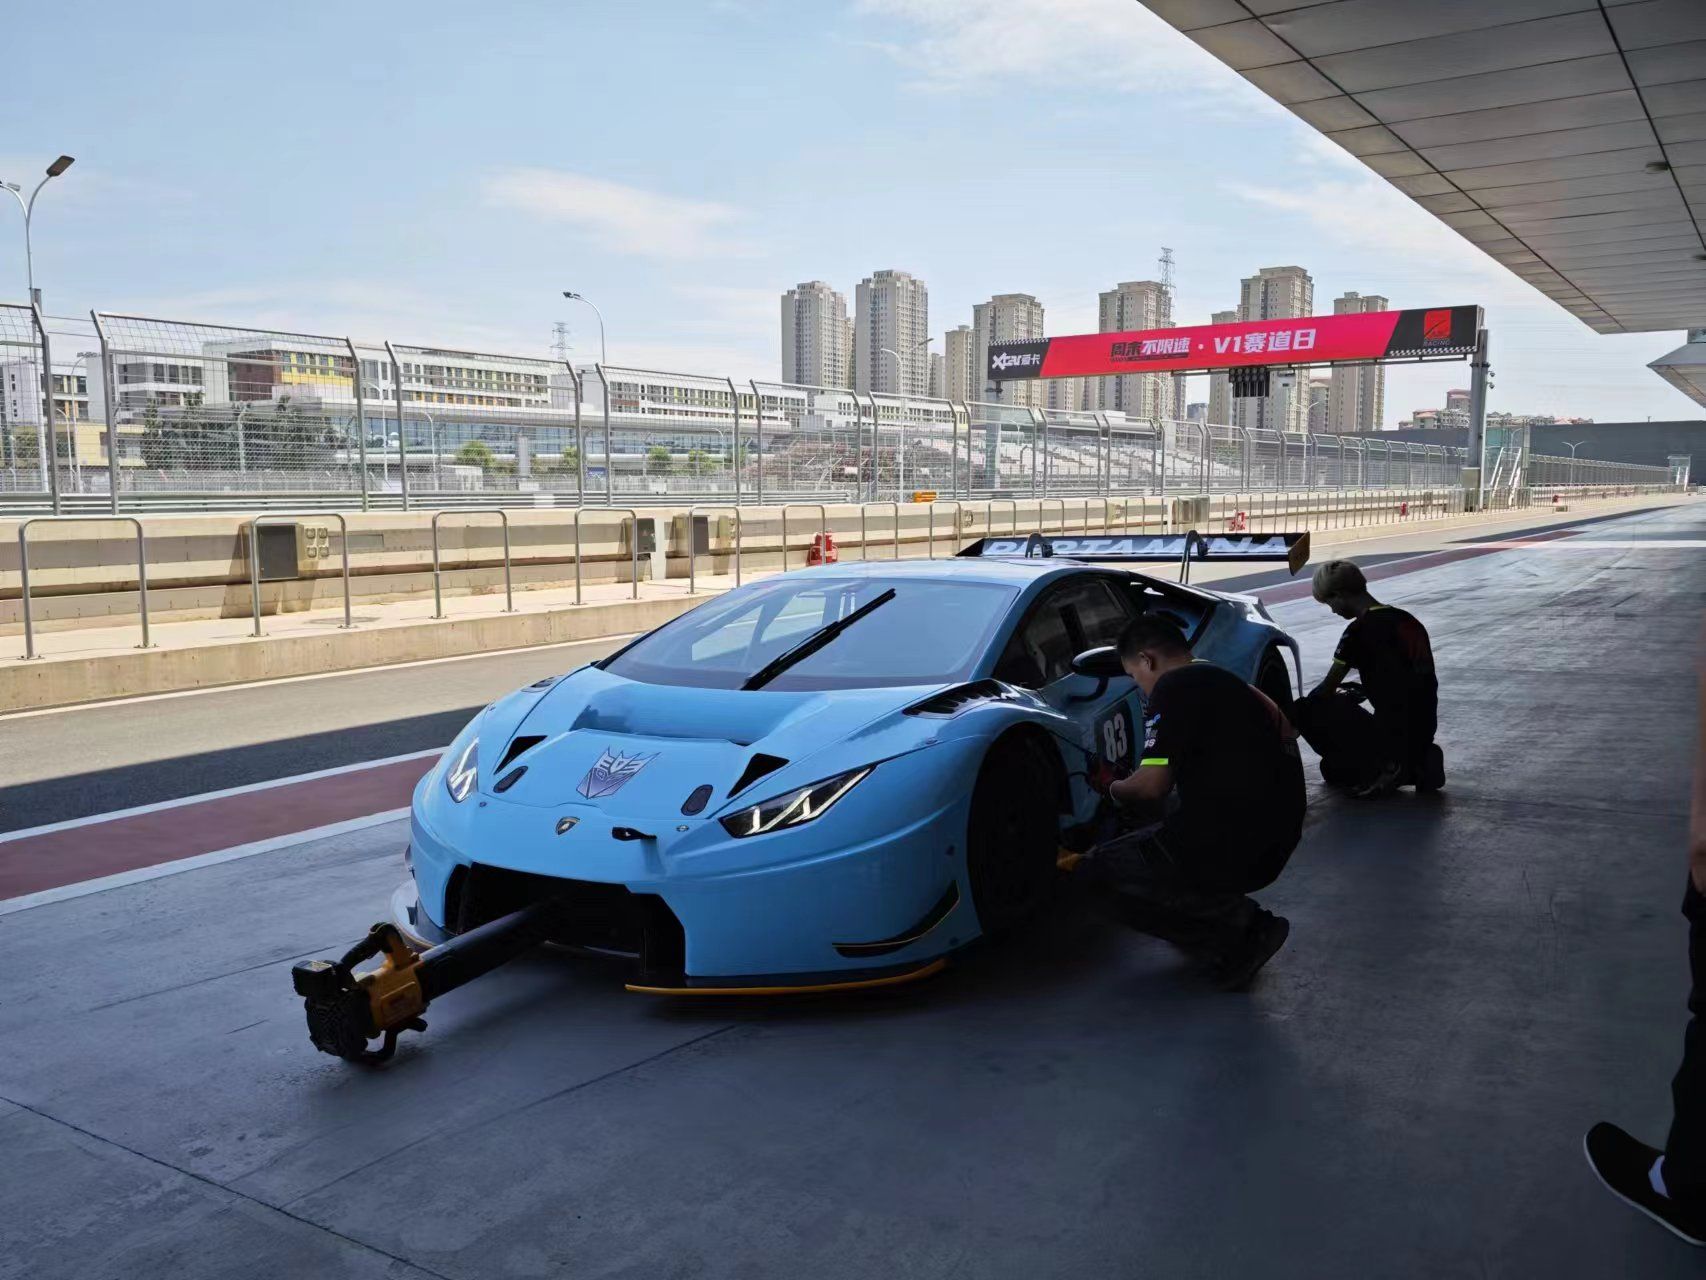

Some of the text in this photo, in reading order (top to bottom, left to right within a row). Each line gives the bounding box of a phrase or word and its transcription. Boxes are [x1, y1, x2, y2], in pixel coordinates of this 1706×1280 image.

[1213, 328, 1317, 354] V1赛道日
[1103, 712, 1129, 762] 83
